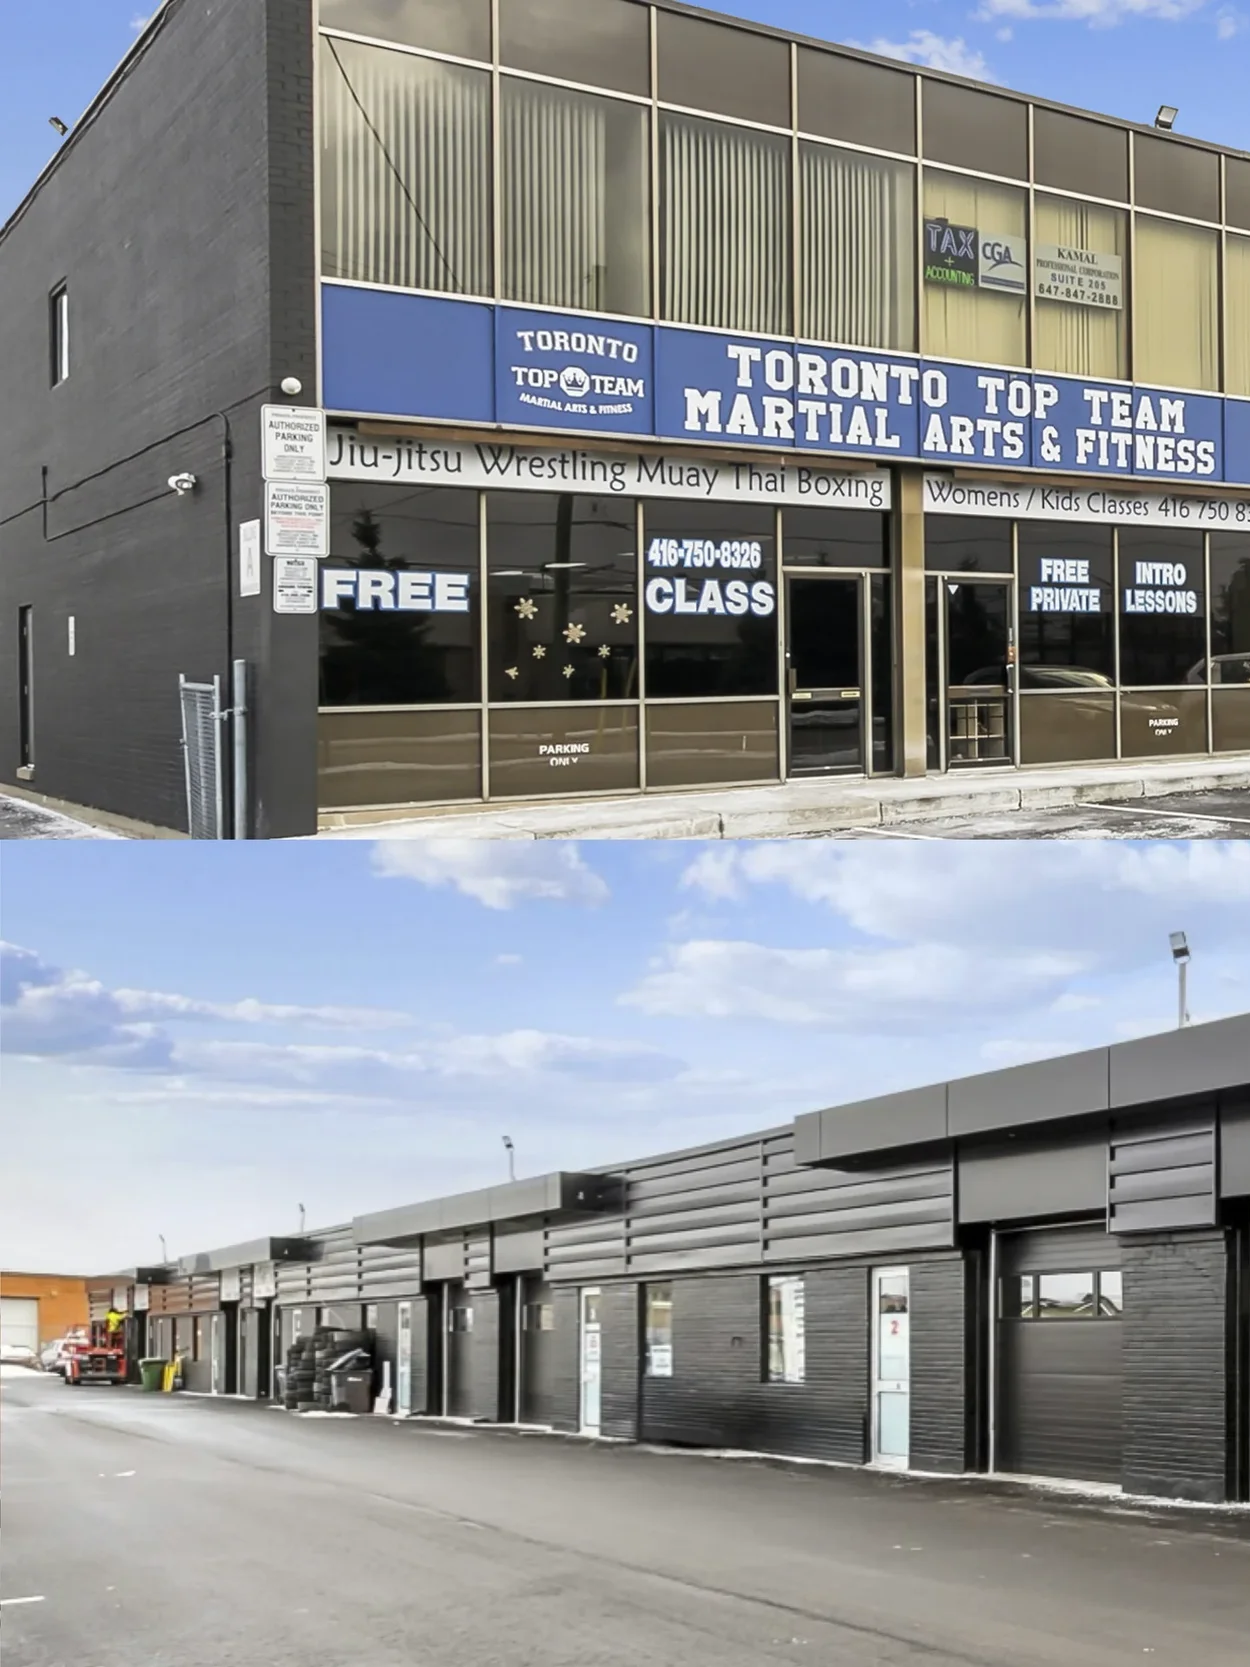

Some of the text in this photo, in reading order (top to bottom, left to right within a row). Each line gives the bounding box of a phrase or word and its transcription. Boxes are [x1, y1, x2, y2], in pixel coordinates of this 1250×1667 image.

[926, 223, 975, 260] TAX
[982, 242, 1012, 263] CGA
[1036, 258, 1077, 273] PROFESSIONAL
[1057, 247, 1098, 265] KAMAL
[925, 265, 975, 286] ACCOUNTING
[1051, 273, 1084, 287] SUITE
[1039, 283, 1118, 305] 647-847-2888
[516, 331, 638, 363] TORONTO
[511, 366, 645, 397] TOP TEAM
[727, 344, 1186, 434] TORONTO TOP TEAM
[519, 392, 633, 415] MARTIAL ARTS & FITNESS
[269, 420, 320, 432] AUTHORIZED
[275, 432, 313, 443] PARKING
[684, 387, 1216, 475] MARTIAL ARTS & FITNESS
[284, 443, 305, 453] ONLY
[329, 433, 462, 478] Jiu-jitsu
[475, 441, 626, 492] Wrestling
[636, 454, 719, 496] Muay
[728, 463, 786, 493] Thai
[798, 467, 884, 507] Boxing
[271, 493, 324, 503] AUTHORIZED
[271, 502, 324, 511] PARKING ONLY
[926, 479, 1020, 510] Womens
[1041, 488, 1081, 513] Kids
[1087, 491, 1149, 517] Classes
[1158, 496, 1190, 519] 416
[1198, 501, 1229, 522] 750
[647, 538, 763, 570] 416-750-8326
[1040, 557, 1090, 583] FREE
[1135, 561, 1187, 586] INTRO
[322, 568, 469, 612] FREE
[645, 576, 775, 616] CLASS
[1030, 585, 1101, 613] PRIVATE
[1125, 588, 1197, 613] LESSONS
[1149, 718, 1179, 727] PARKING
[539, 743, 590, 755] PARKING
[890, 1319, 899, 1335] 2
